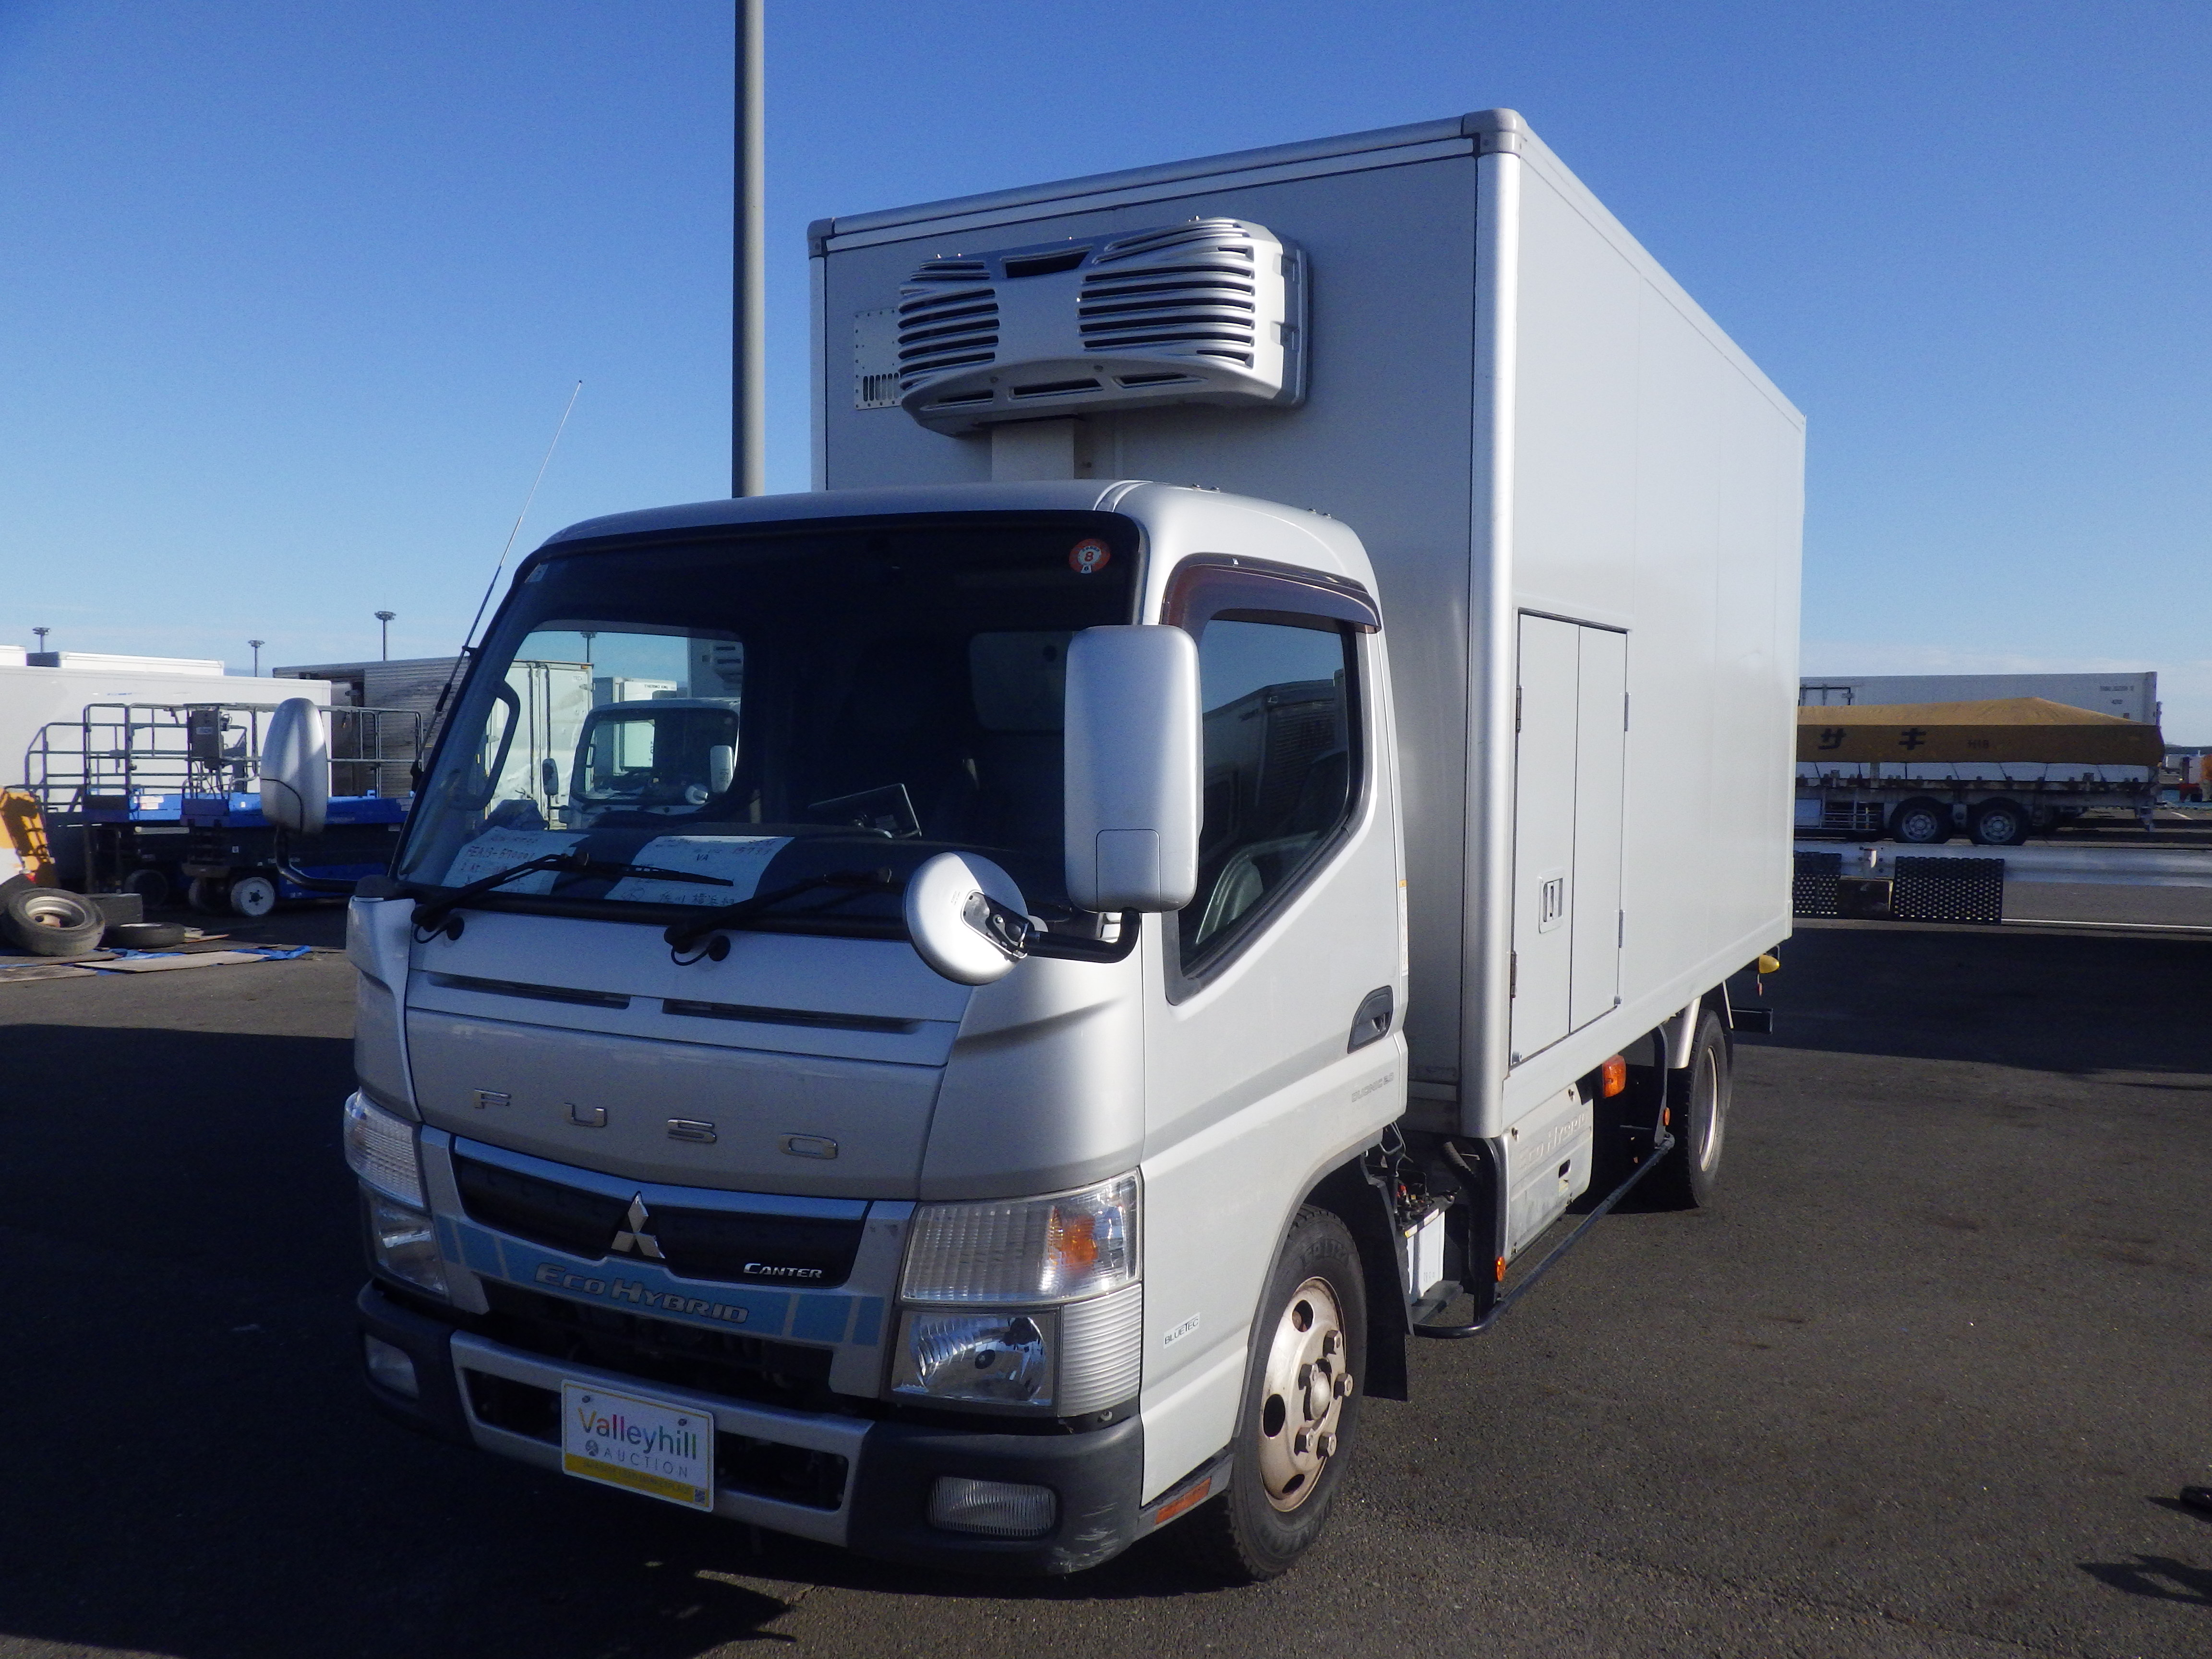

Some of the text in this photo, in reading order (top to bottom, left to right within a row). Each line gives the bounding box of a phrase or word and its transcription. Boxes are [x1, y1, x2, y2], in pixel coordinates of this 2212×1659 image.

[1084, 551, 1094, 562] 8
[473, 1088, 839, 1160] FUSO
[1164, 1316, 1199, 1345] BLUETEC
[577, 1407, 697, 1460] Valleyhill
[603, 1447, 688, 1479] AUCTION
